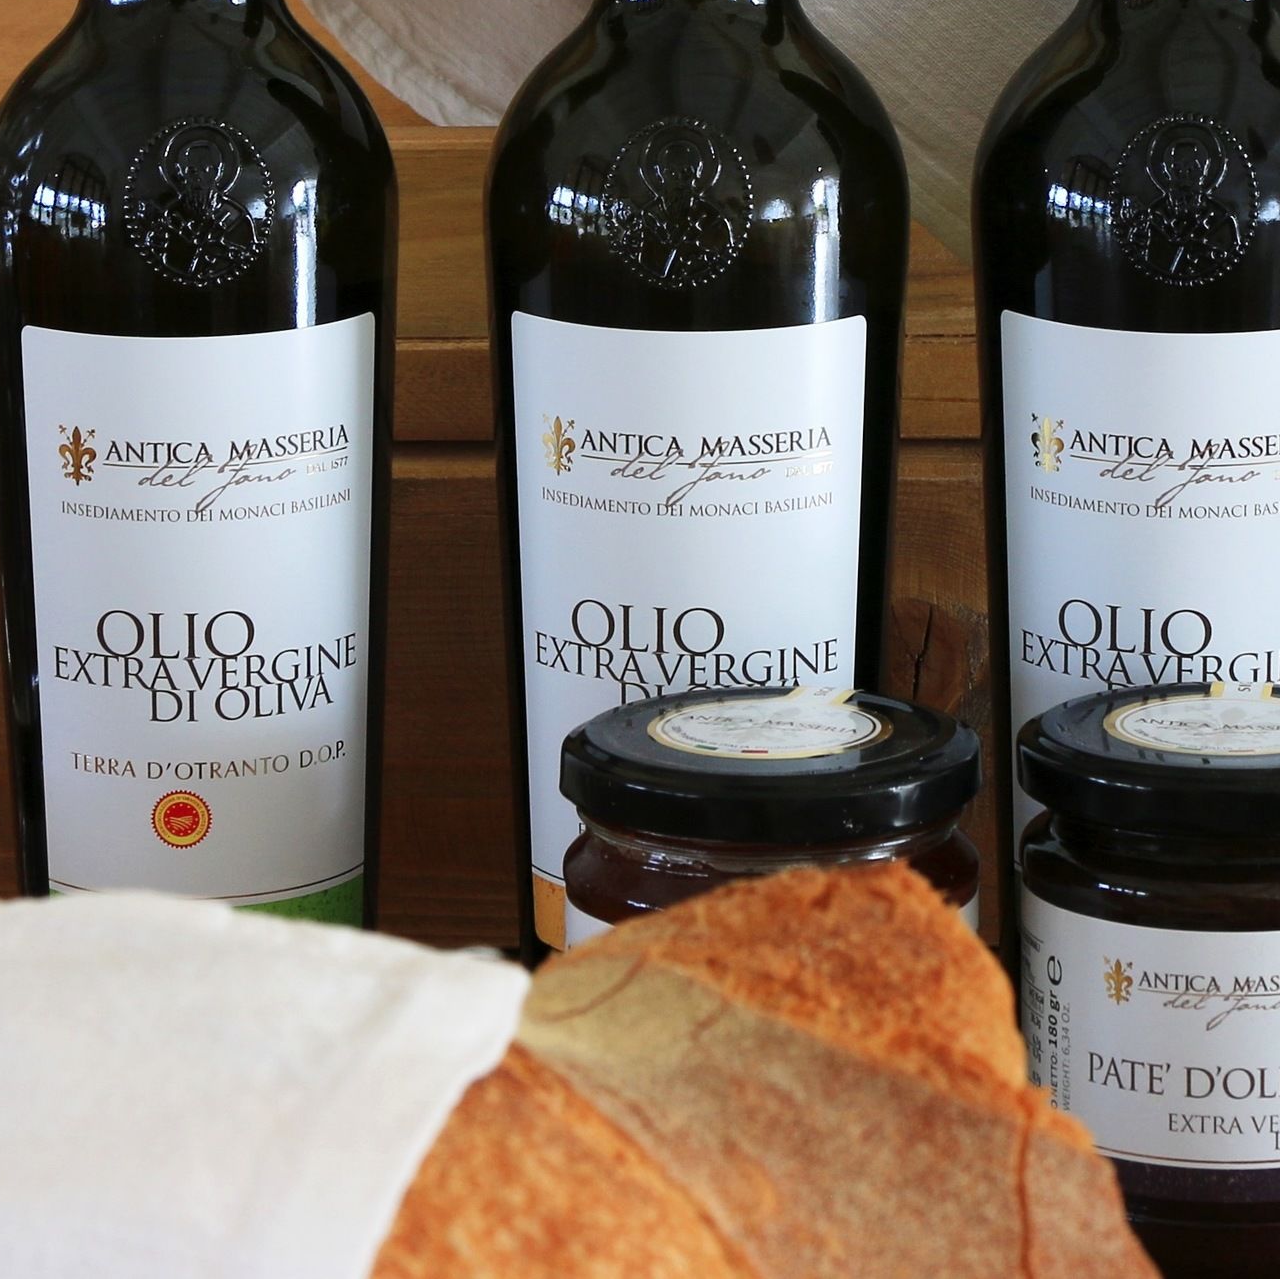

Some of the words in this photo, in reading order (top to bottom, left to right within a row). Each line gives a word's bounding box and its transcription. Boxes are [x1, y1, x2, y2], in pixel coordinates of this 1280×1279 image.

[106, 440, 214, 464] ANTICA
[229, 424, 349, 463] MASSERIA
[580, 428, 684, 458] ANTICA
[699, 426, 832, 458] MASSERIA
[1070, 429, 1174, 460] ANTICA
[138, 454, 214, 488] del
[610, 448, 684, 481] del
[1099, 451, 1174, 482] del
[61, 501, 181, 523] INSEDIAMENTO
[186, 509, 213, 523] DEI
[219, 502, 285, 521] MONACI
[291, 488, 351, 515] BASILIANI
[541, 486, 651, 517] INSEDIAMENTO
[656, 502, 683, 517] DEI
[689, 502, 759, 517] MONACI
[764, 491, 833, 513] BASILIANI
[1031, 486, 1140, 517] INSEDIAMENTO
[1146, 504, 1172, 518] DEI
[1178, 503, 1247, 519] MONACI
[96, 610, 255, 659] OLIO
[571, 599, 725, 655] OLIO
[1058, 599, 1212, 656] OLIO
[150, 689, 199, 722] DI
[214, 674, 334, 721] OLIVA
[71, 751, 136, 778] TERRA
[147, 754, 290, 780] D'OTRANTO
[299, 740, 346, 769] D.O.P.
[1138, 969, 1220, 993] ANTICA
[1050, 990, 1061, 1012] gr
[1048, 1015, 1058, 1049] 180
[1062, 1027, 1072, 1055] 6,34
[1088, 1051, 1172, 1097] PATE'
[1168, 1112, 1244, 1134] EXTRA
